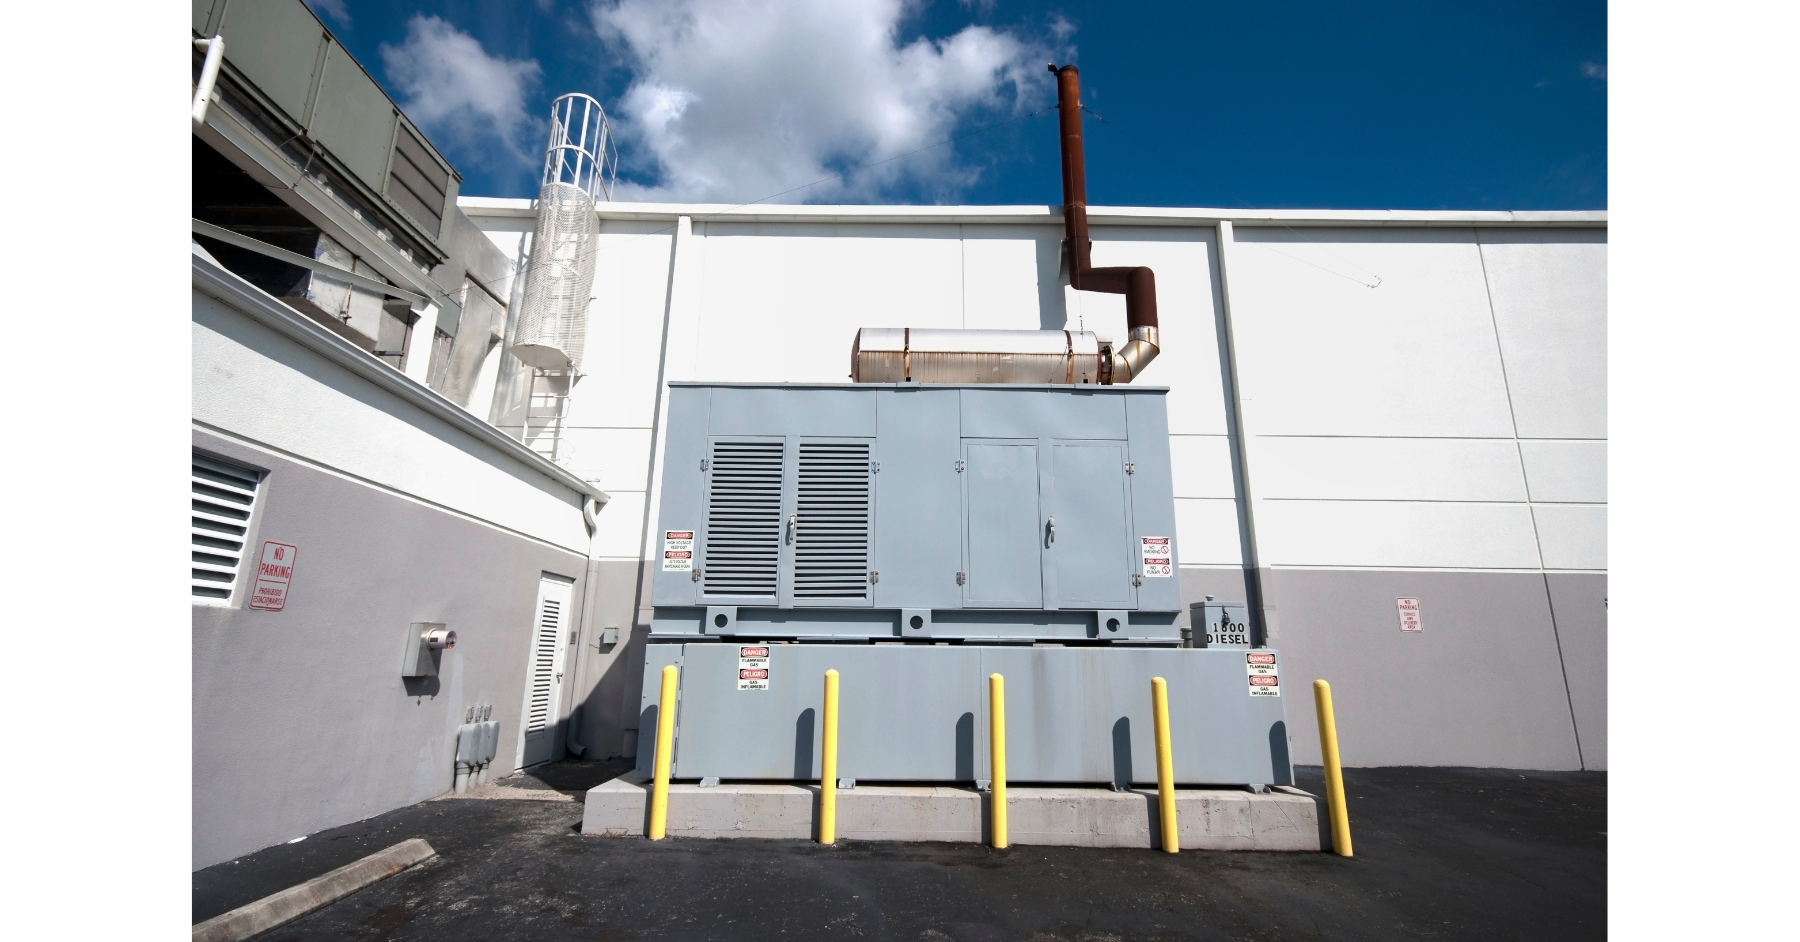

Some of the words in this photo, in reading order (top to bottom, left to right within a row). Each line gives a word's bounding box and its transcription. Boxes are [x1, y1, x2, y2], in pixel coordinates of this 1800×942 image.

[274, 548, 285, 560] NO
[260, 563, 291, 579] PARKING
[258, 587, 282, 596] PROHIBIDO
[1206, 634, 1249, 644] DIESEL
